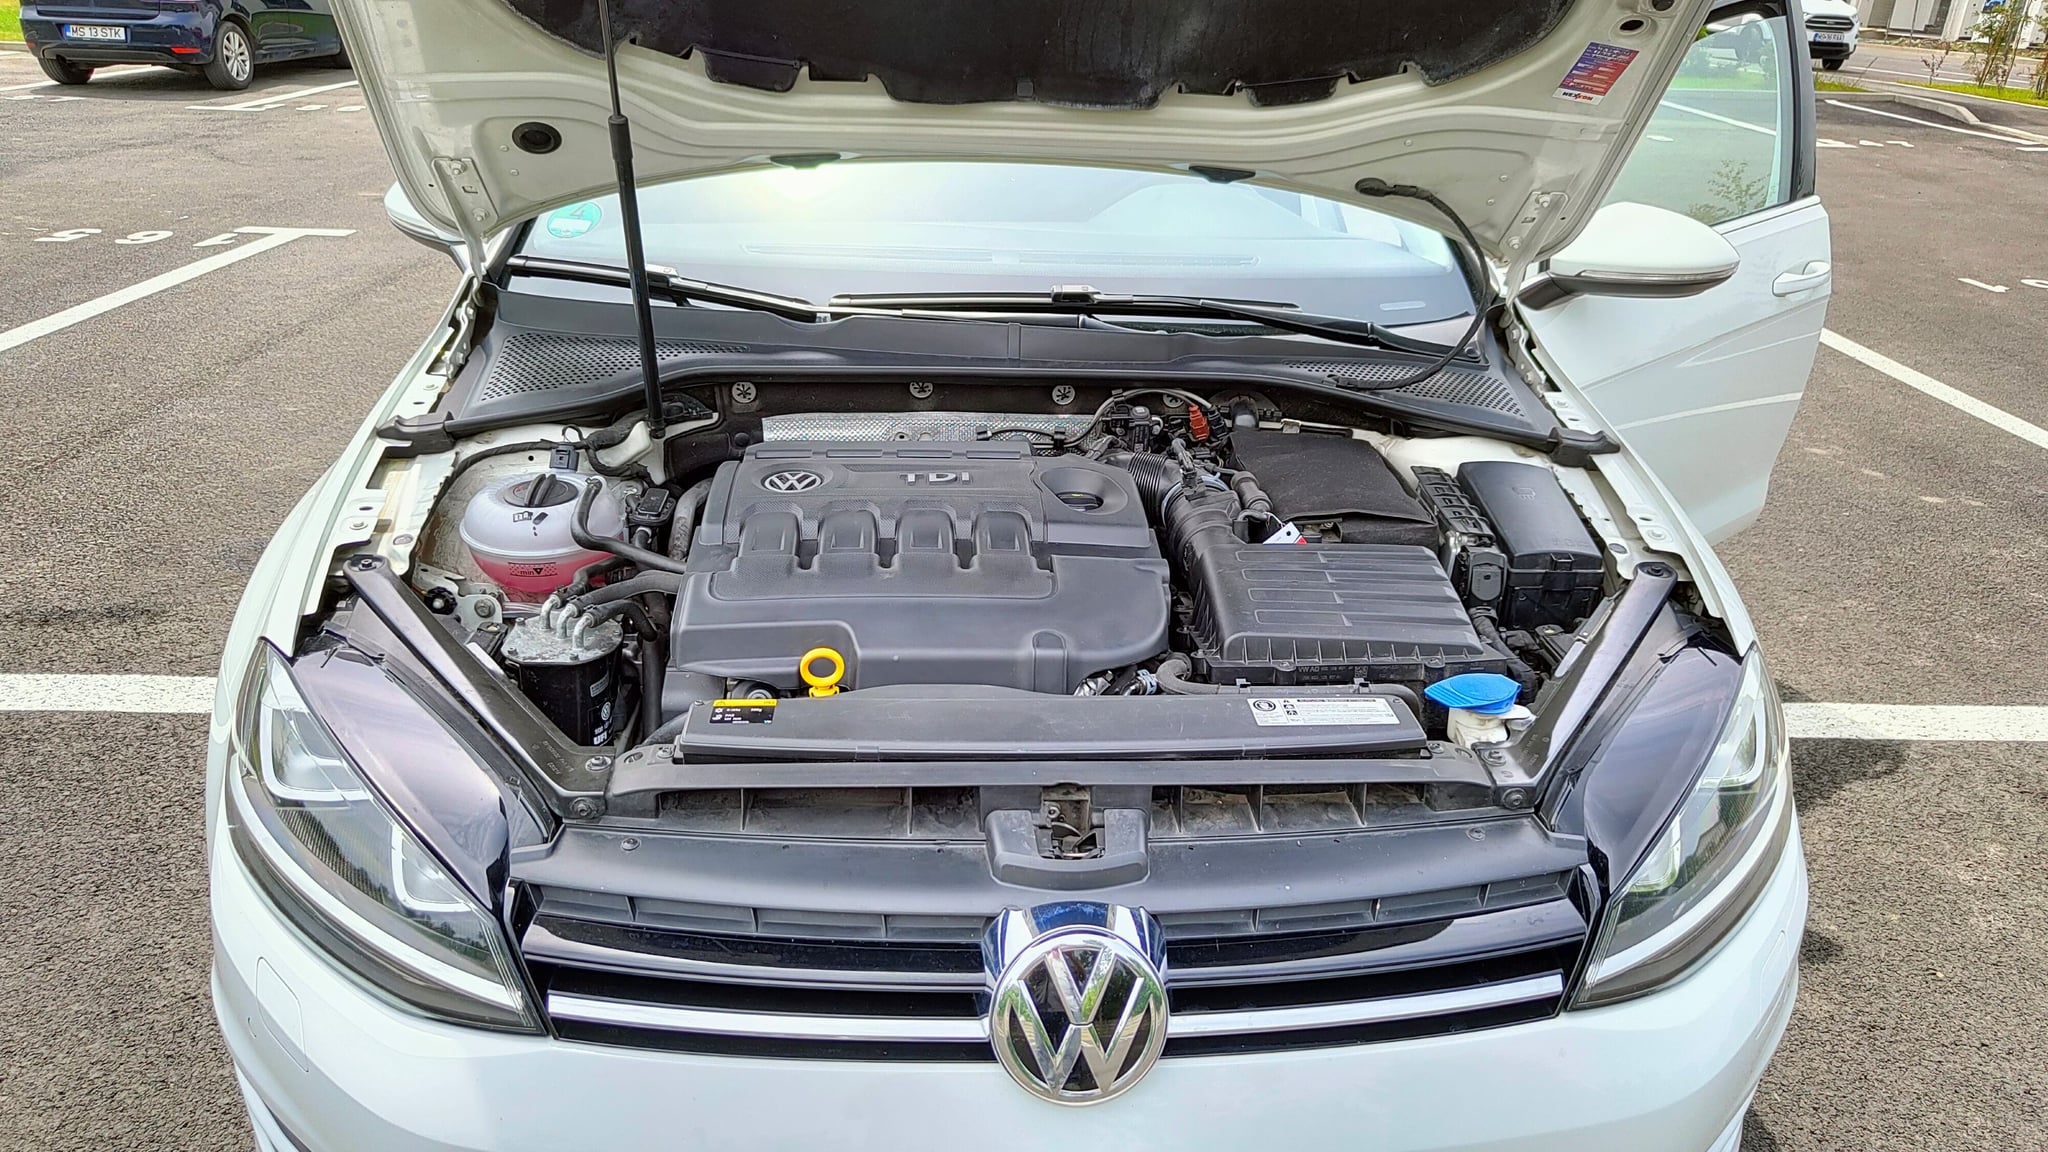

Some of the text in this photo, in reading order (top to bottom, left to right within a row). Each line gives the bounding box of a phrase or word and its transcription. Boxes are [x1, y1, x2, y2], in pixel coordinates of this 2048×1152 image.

[71, 26, 121, 38] MS 13 STK
[901, 471, 970, 484] TDI
